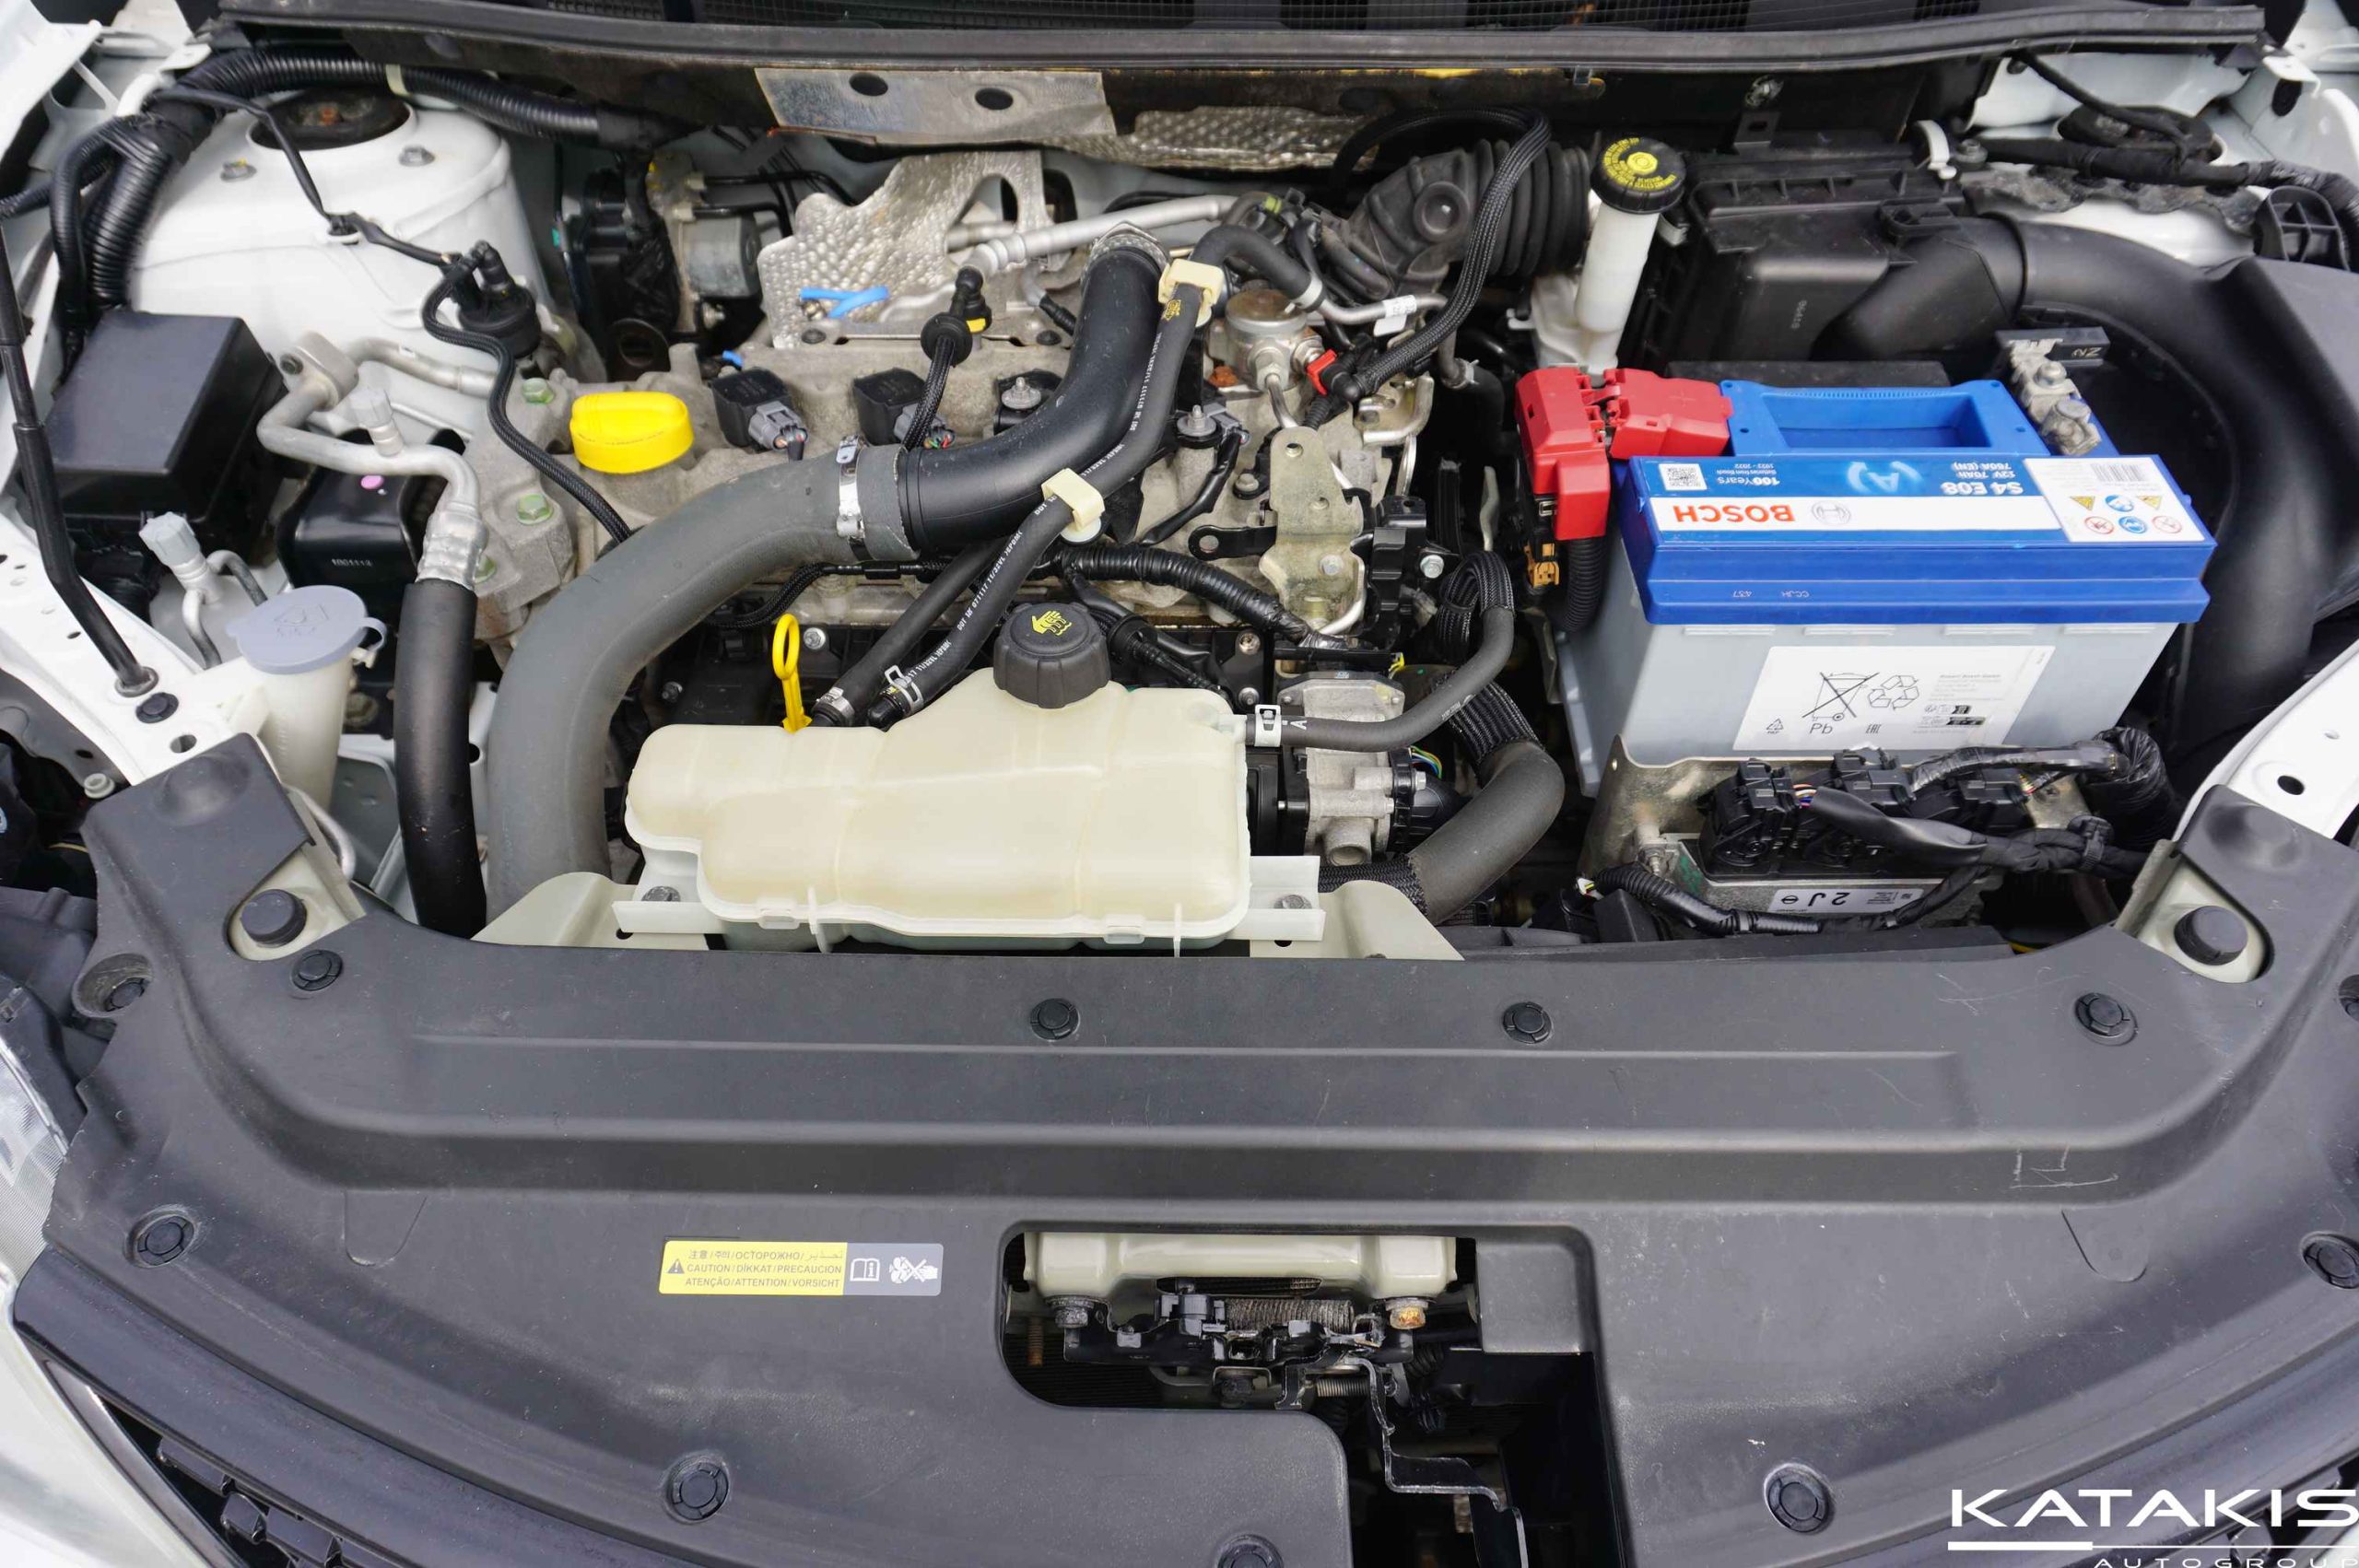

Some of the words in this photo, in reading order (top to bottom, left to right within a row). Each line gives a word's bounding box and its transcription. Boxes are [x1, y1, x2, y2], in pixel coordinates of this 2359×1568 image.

[1940, 482, 1988, 495] E08
[1989, 482, 2024, 495] S4
[1673, 505, 1796, 522] BOSCH
[1809, 722, 1834, 734] Pb
[687, 1263, 731, 1273] CAUTION
[734, 1278, 788, 1287] ATTENTION
[792, 1279, 840, 1288] VORSICHT
